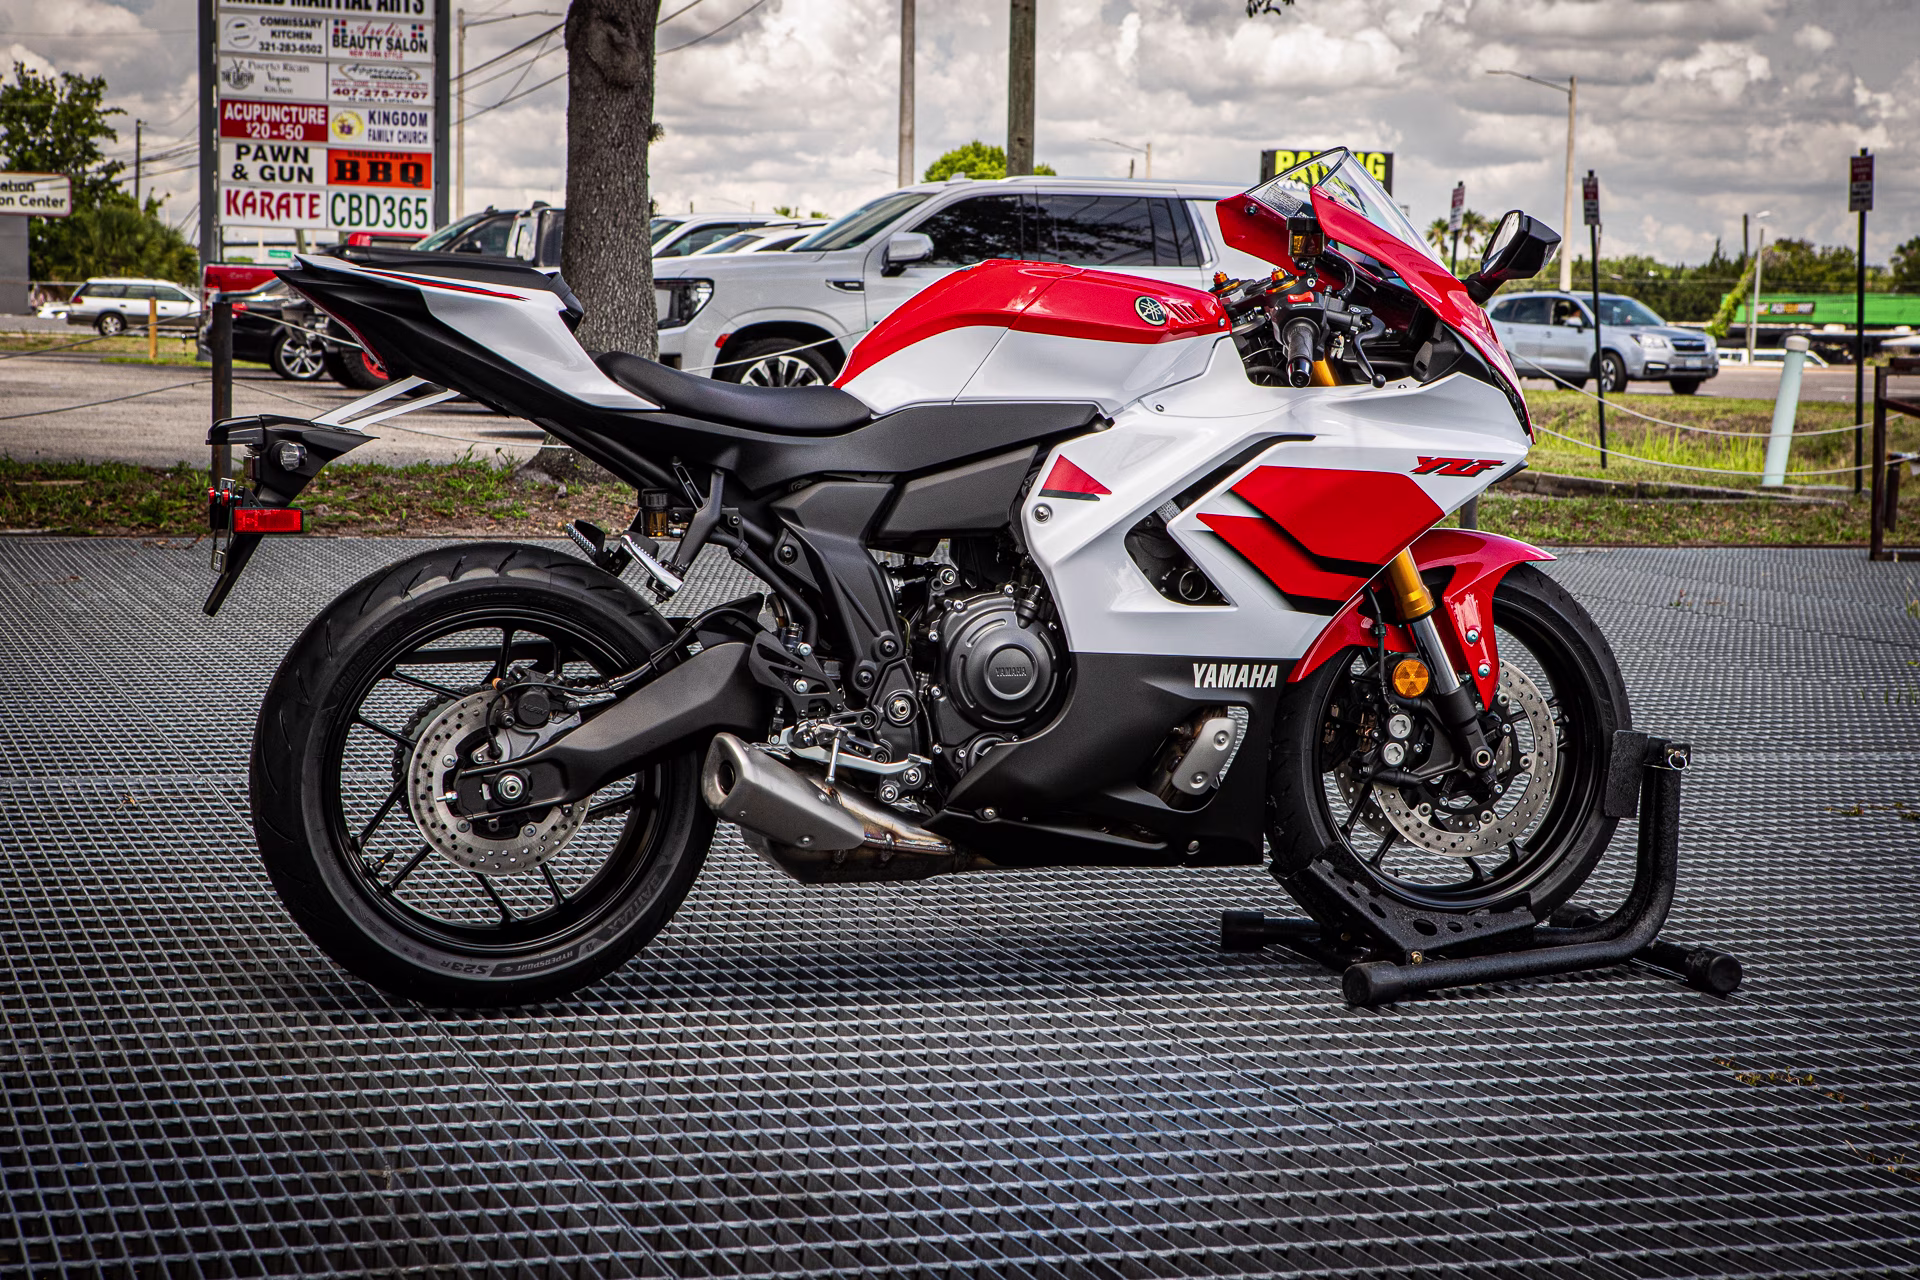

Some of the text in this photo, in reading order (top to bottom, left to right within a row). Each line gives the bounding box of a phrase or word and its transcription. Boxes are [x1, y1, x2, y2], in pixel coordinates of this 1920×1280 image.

[259, 16, 322, 28] COMMISSARY
[271, 30, 312, 40] KITCHEN
[332, 34, 428, 53] BEAUTY SALON
[224, 102, 326, 125] ACUPUNCTURE
[368, 110, 428, 127] KINGDOM
[368, 128, 428, 144] FAMILY CHURCH
[236, 143, 309, 163] PAWN
[232, 163, 314, 183] & GUN
[334, 158, 424, 187] BBQ
[19, 195, 65, 207] Center
[226, 188, 321, 220] KARATE
[331, 192, 428, 229] CBD365
[995, 666, 1027, 677] YAMAHA
[1193, 663, 1278, 688] YAMAHA
